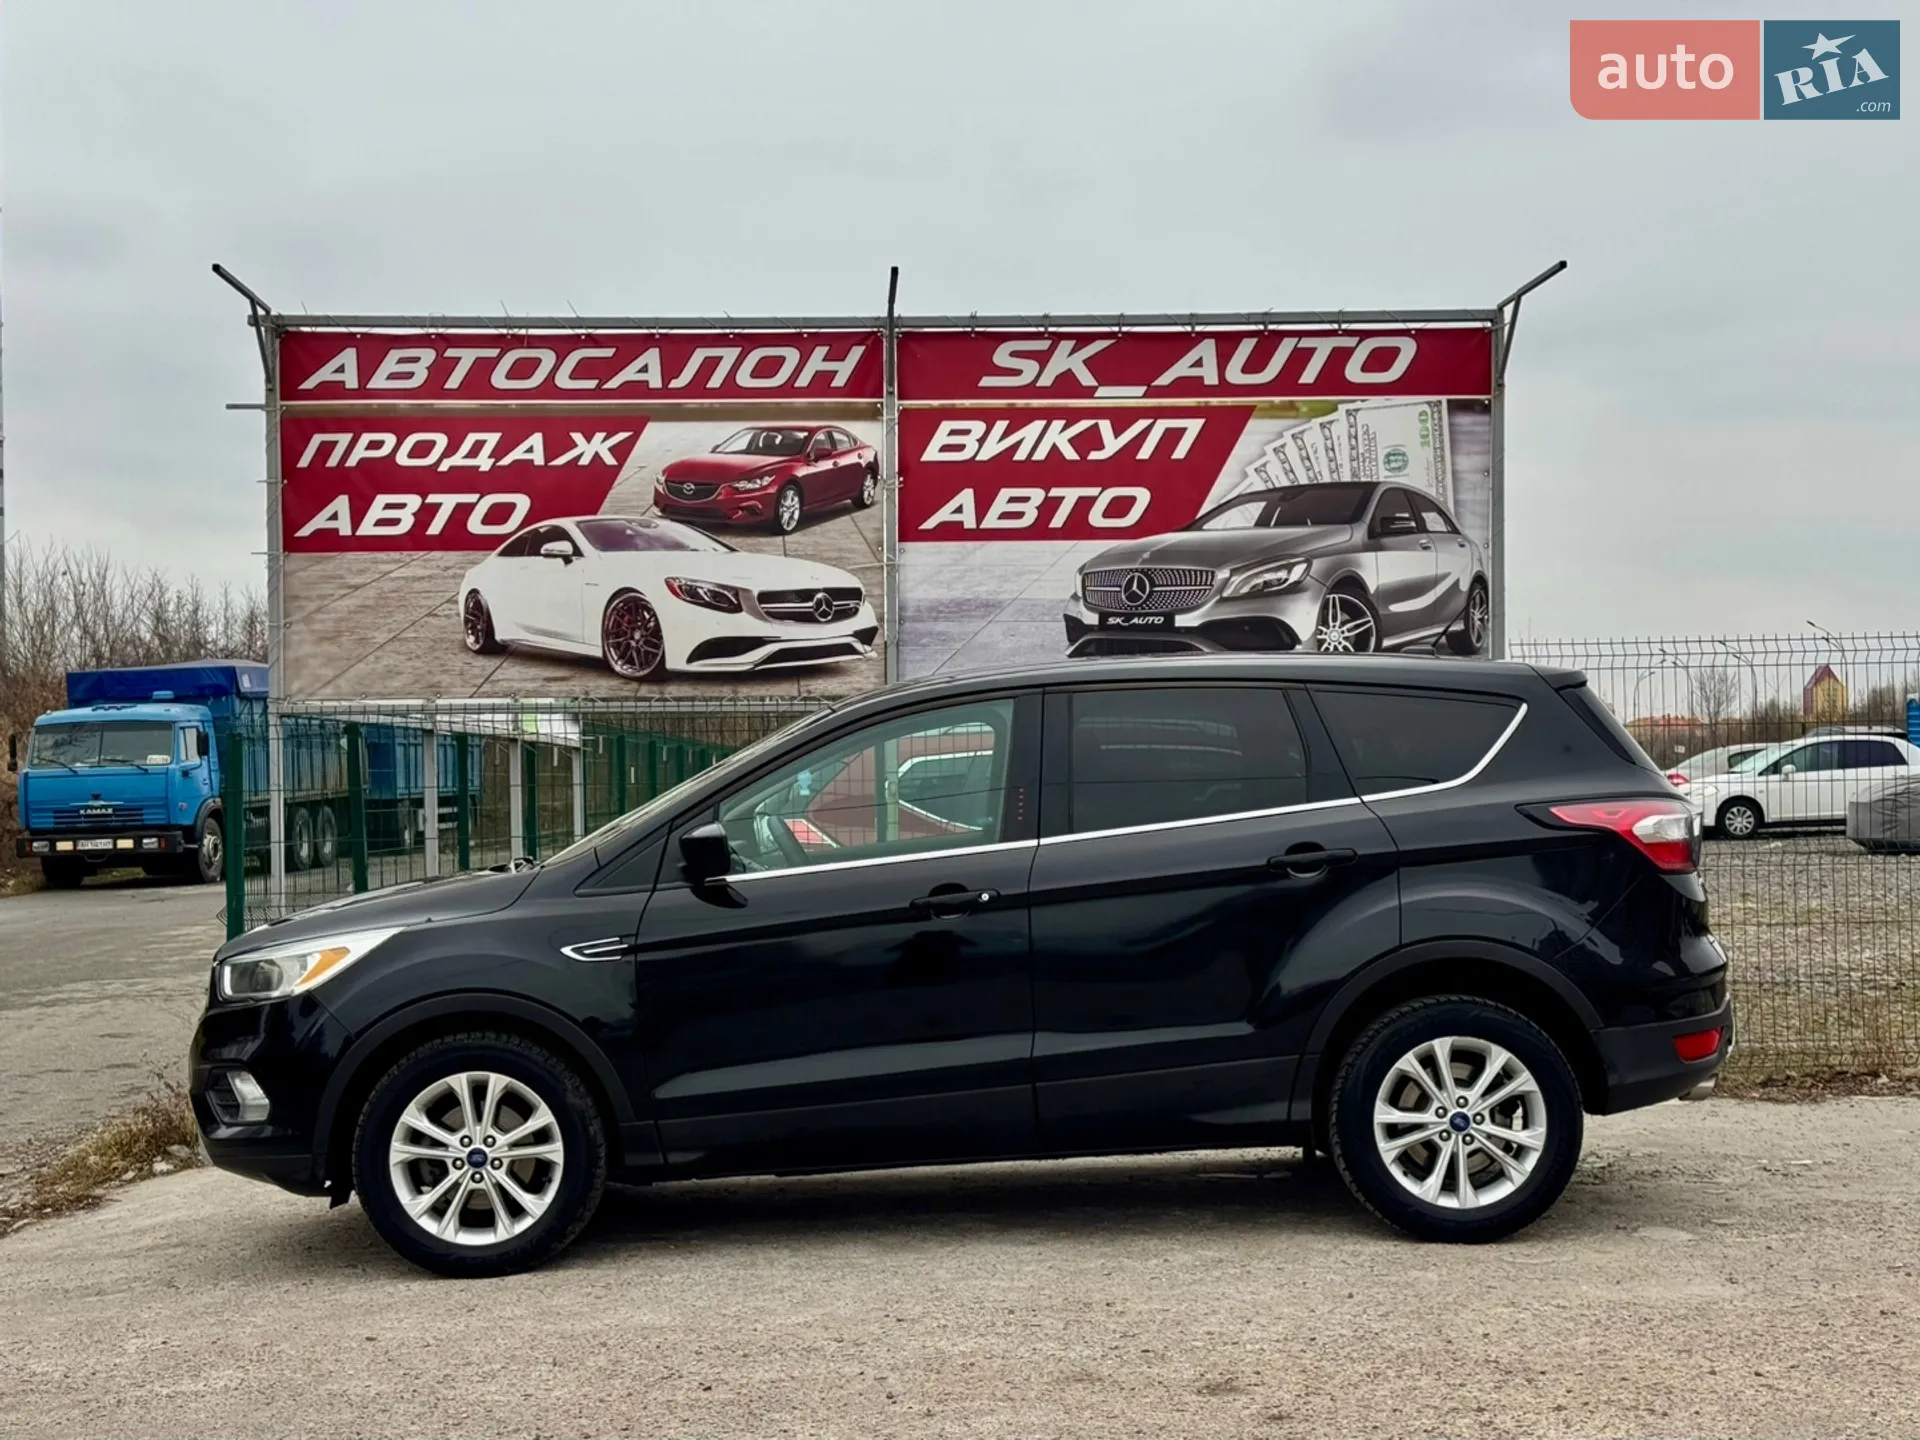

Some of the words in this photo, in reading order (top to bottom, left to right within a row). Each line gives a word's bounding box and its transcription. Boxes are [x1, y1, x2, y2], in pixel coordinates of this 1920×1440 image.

[297, 346, 866, 390] АВТОСАЛОН
[978, 336, 1417, 397] SK_AUTO
[296, 431, 633, 472] ПРОДАЖ
[920, 418, 1206, 462] ВИКУП
[294, 493, 531, 537] АВТО
[918, 486, 1151, 530] АВТО
[1106, 616, 1165, 627] SK_AUTO
